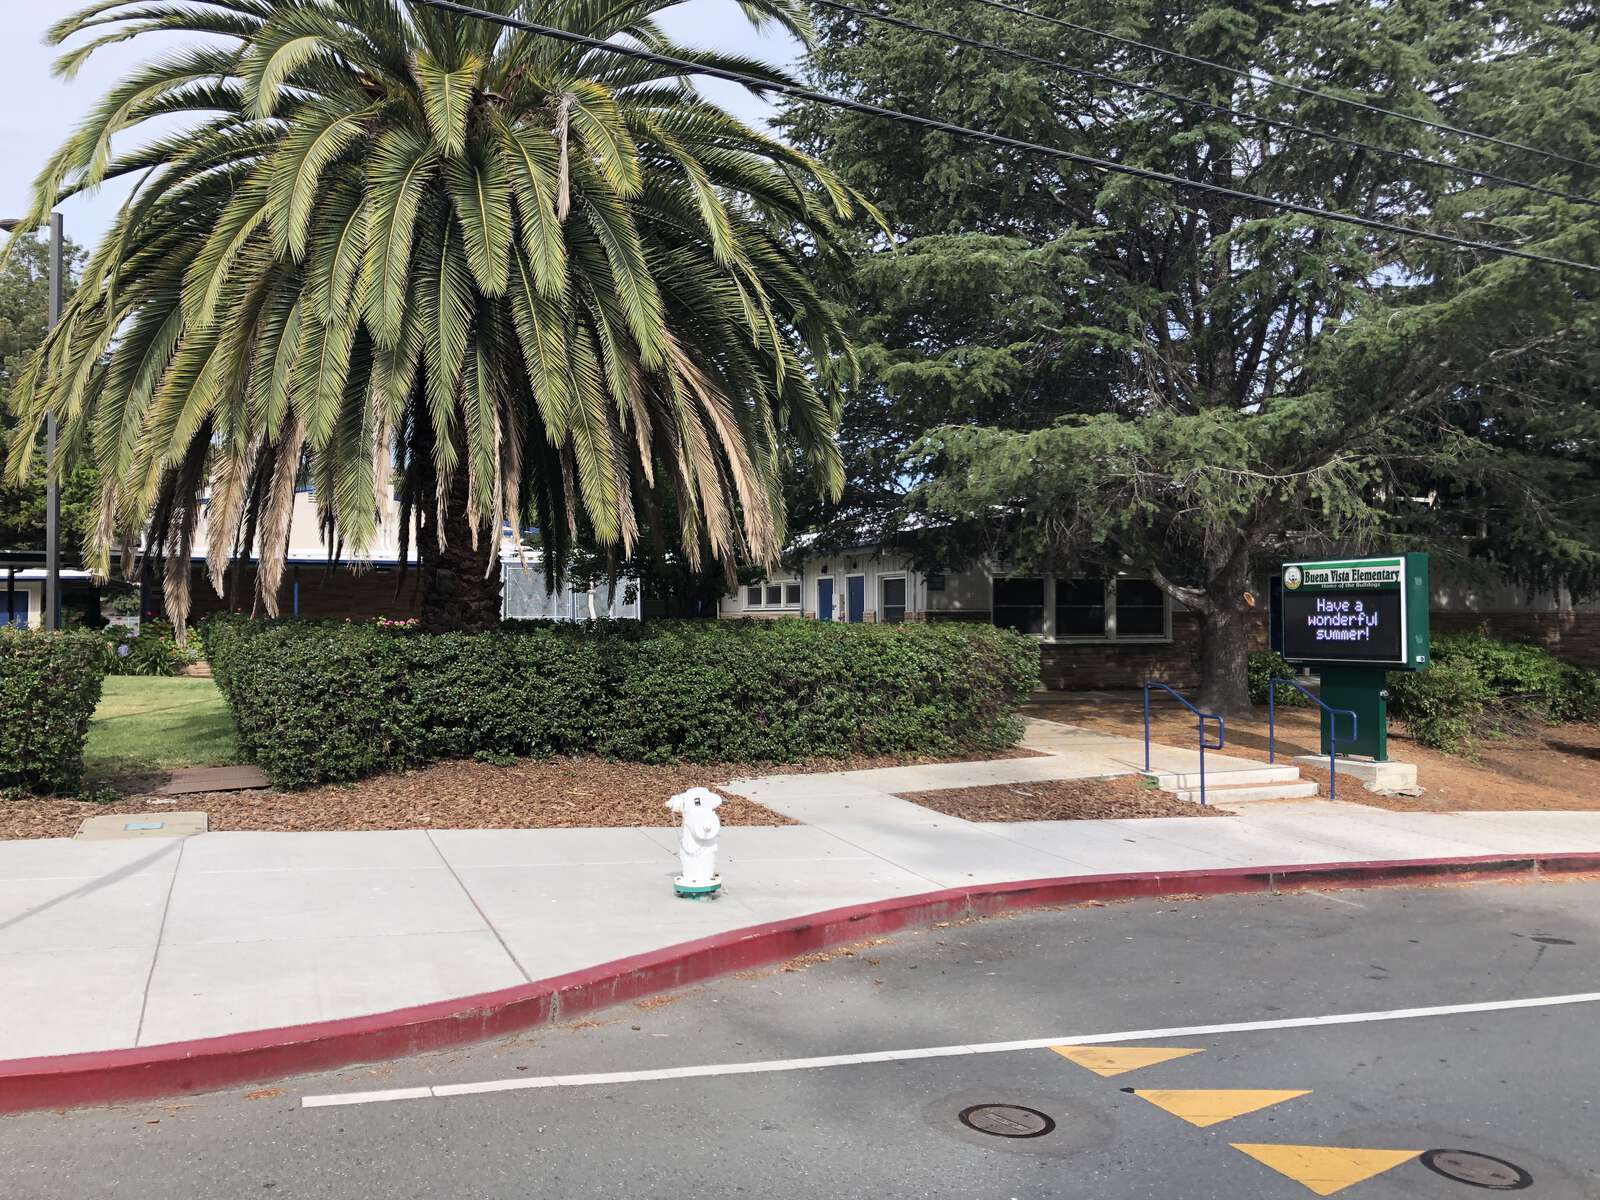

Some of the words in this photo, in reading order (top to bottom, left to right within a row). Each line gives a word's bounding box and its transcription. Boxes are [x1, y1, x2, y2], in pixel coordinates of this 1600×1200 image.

[1305, 571, 1329, 583] Buena
[1331, 570, 1350, 582] Vista
[1352, 569, 1400, 582] Elementary
[1317, 598, 1350, 612] Have
[1355, 601, 1363, 612] a
[1308, 611, 1378, 626] wonderful
[1316, 626, 1369, 640] summer!
